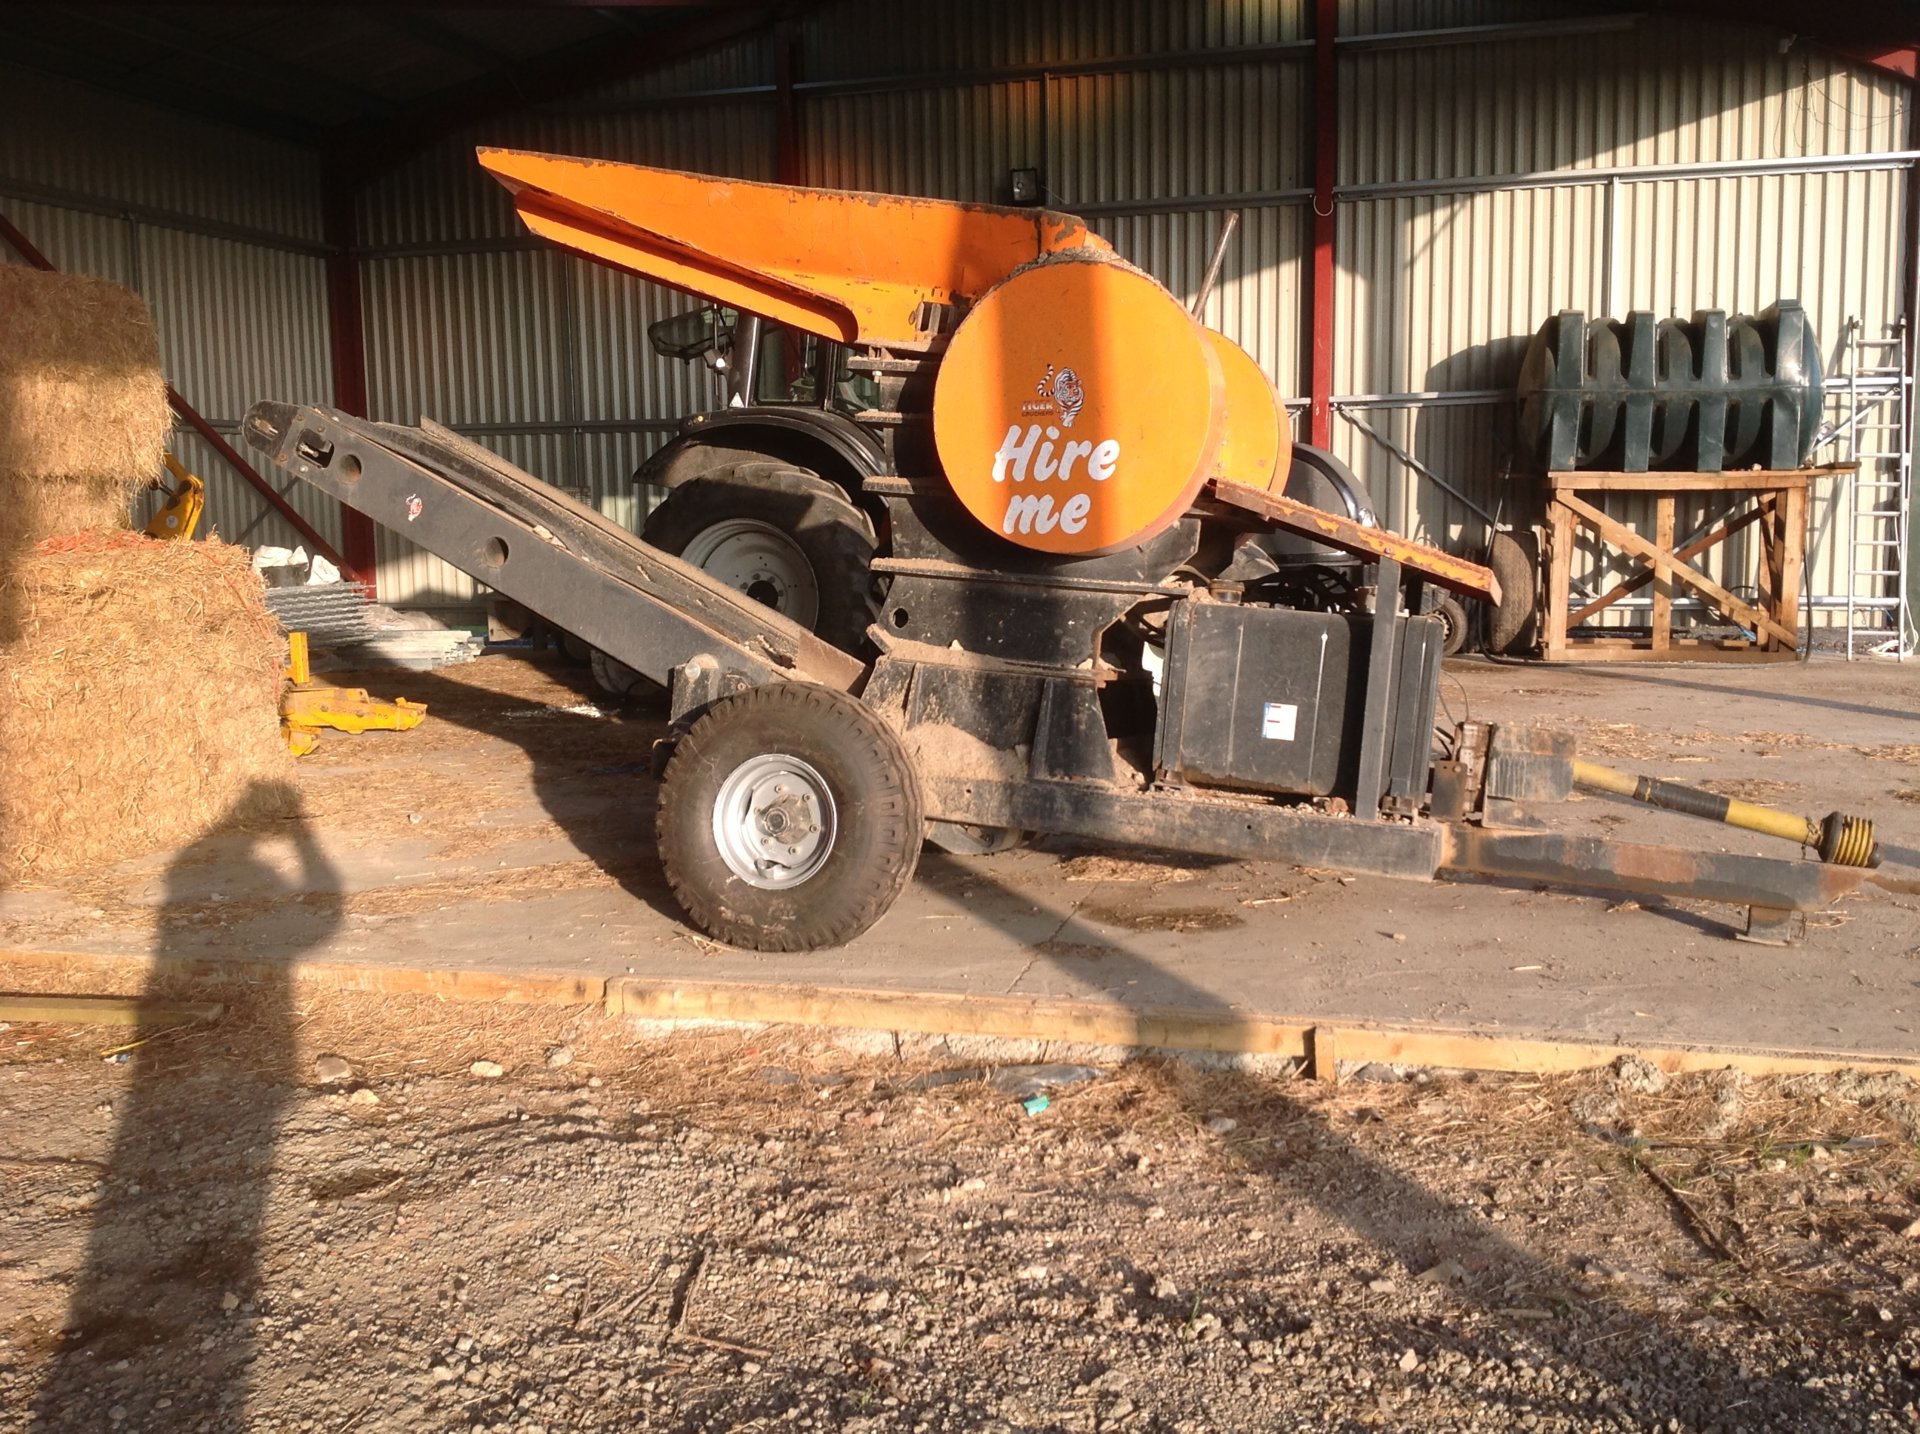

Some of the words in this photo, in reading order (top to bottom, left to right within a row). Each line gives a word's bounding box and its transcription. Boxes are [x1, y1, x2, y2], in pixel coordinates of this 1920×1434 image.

[1022, 400, 1053, 410] TIGER
[992, 424, 1120, 482] Hire
[1003, 493, 1091, 534] me
